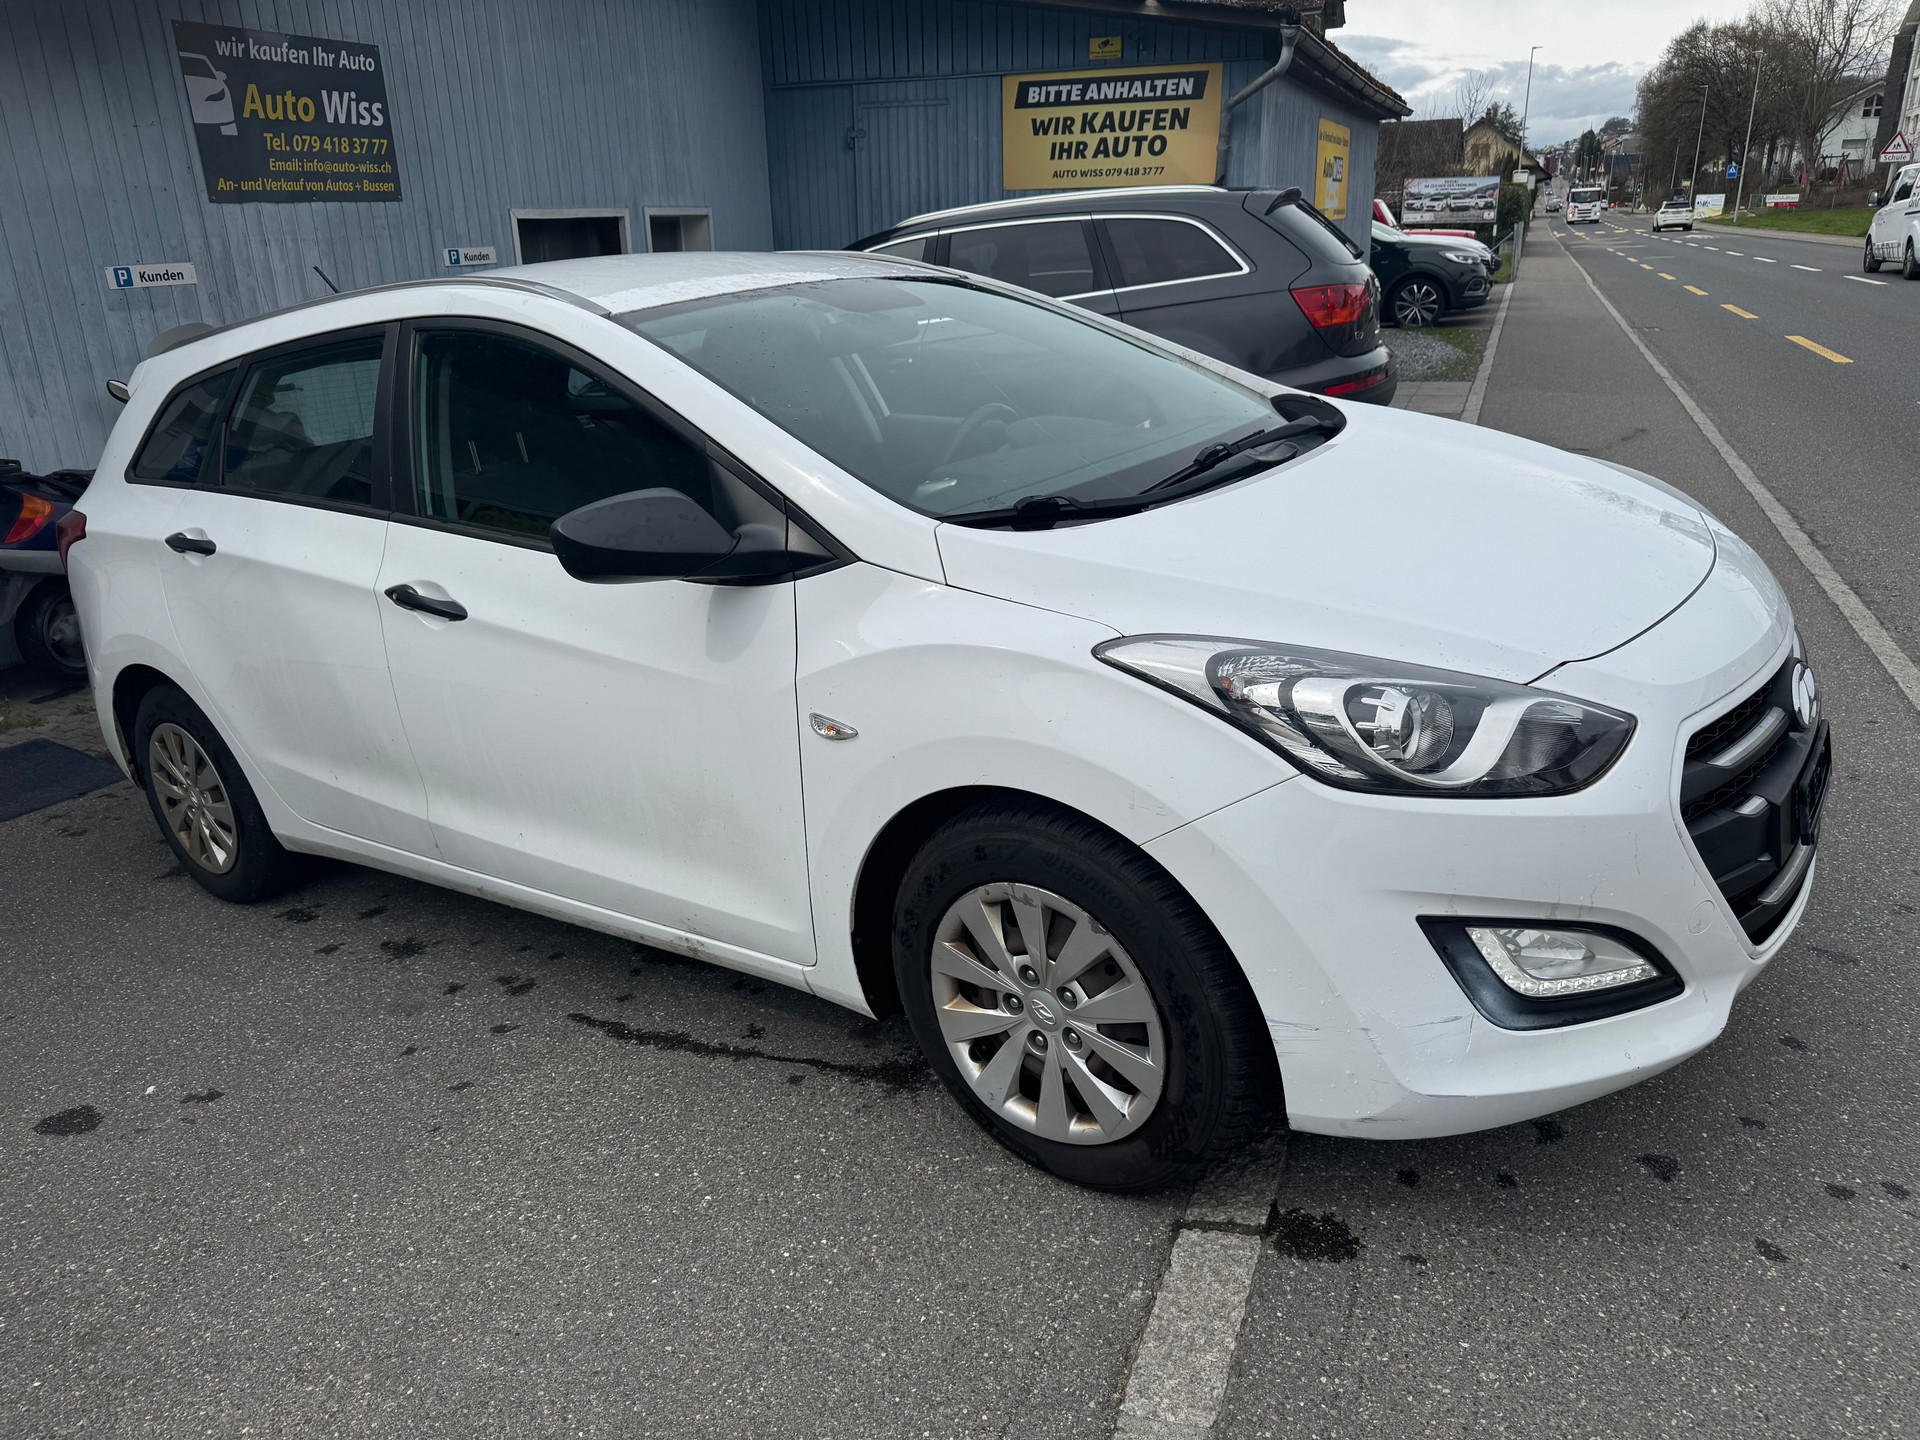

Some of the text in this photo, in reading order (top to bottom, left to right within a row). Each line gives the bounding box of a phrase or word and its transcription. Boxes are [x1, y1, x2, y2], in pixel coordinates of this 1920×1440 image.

[215, 36, 375, 72] wir kaufen Ihr Auto
[1027, 77, 1194, 104] BITTE ANHALTEN
[242, 83, 385, 127] Auto Wiss
[1031, 107, 1190, 136] WIR KAUFEN
[263, 132, 388, 155] Tel. 079 418 37 77
[1050, 134, 1167, 160] IHR AUTO
[269, 158, 392, 174] Email: info@auto-wiss.ch
[1883, 153, 1907, 161] Schule
[1052, 166, 1165, 179] AUTO WISS 079 418 37 77
[217, 178, 239, 191] An-
[241, 177, 263, 191] und
[264, 178, 304, 192] Verkauf
[305, 181, 324, 192] von
[326, 179, 354, 192] Autos
[363, 180, 395, 192] Bussen
[463, 251, 490, 262] Kunden
[138, 269, 185, 283] Kunden
